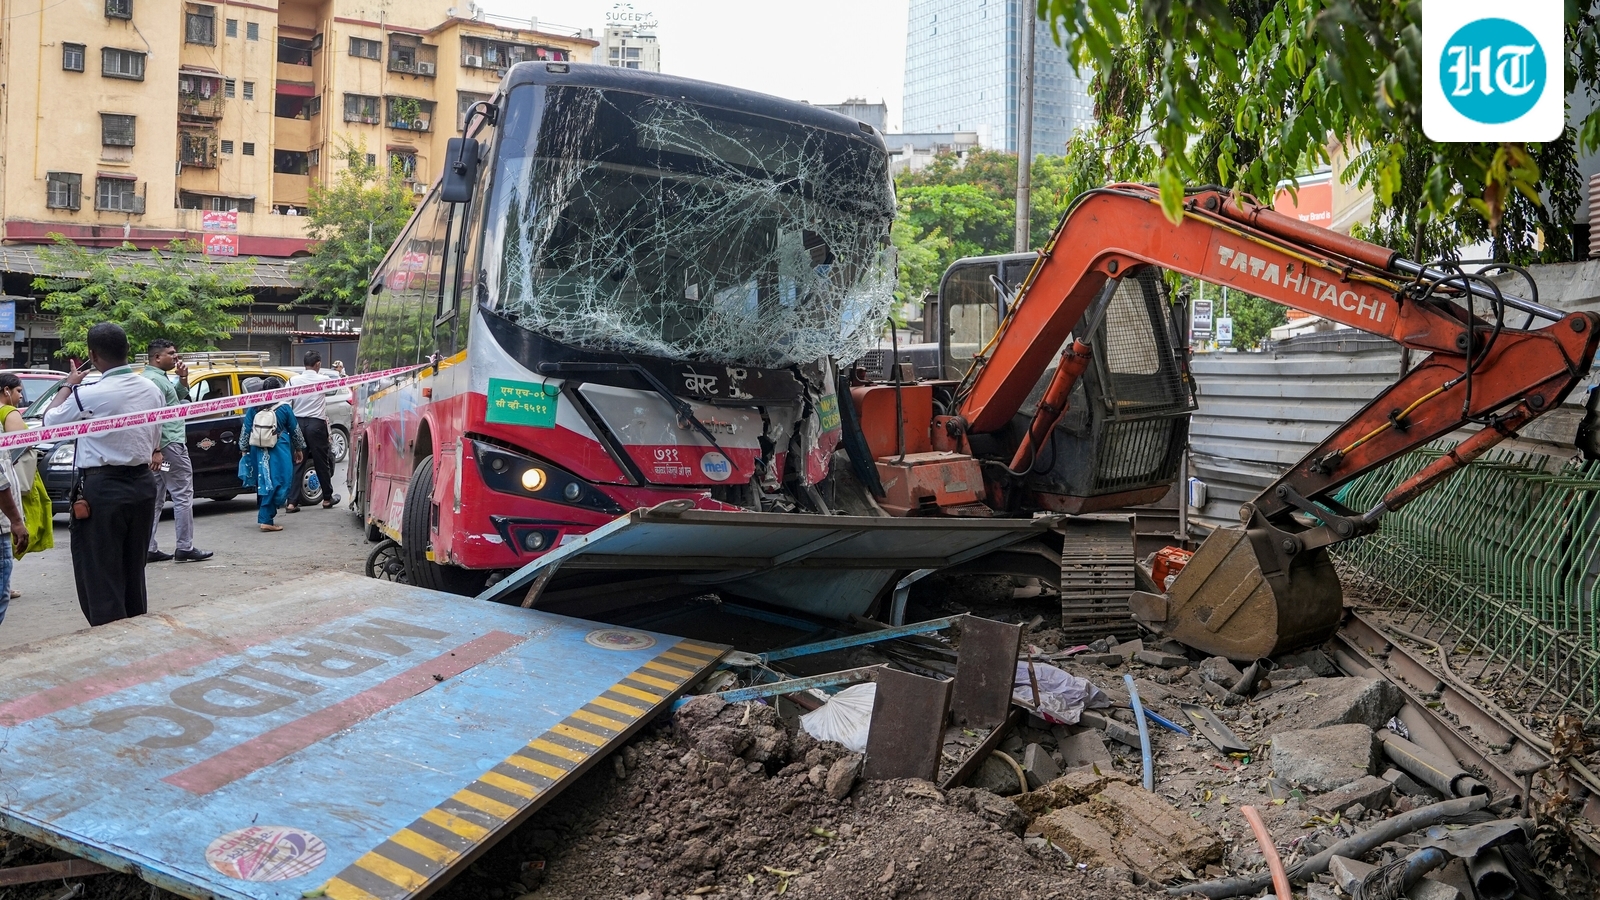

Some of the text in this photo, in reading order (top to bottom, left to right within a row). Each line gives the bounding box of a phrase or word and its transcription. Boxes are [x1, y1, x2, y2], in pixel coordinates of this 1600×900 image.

[1298, 211, 1331, 222] Your Brand is
[1217, 245, 1387, 323] TATA HITACHI
[682, 364, 719, 396] बेस्ट
[500, 386, 514, 397] एम
[495, 398, 506, 408] सी
[653, 448, 679, 462] ७११
[704, 460, 728, 473] meil
[89, 616, 451, 750] MRIDC
[209, 826, 263, 857] MRIDC
